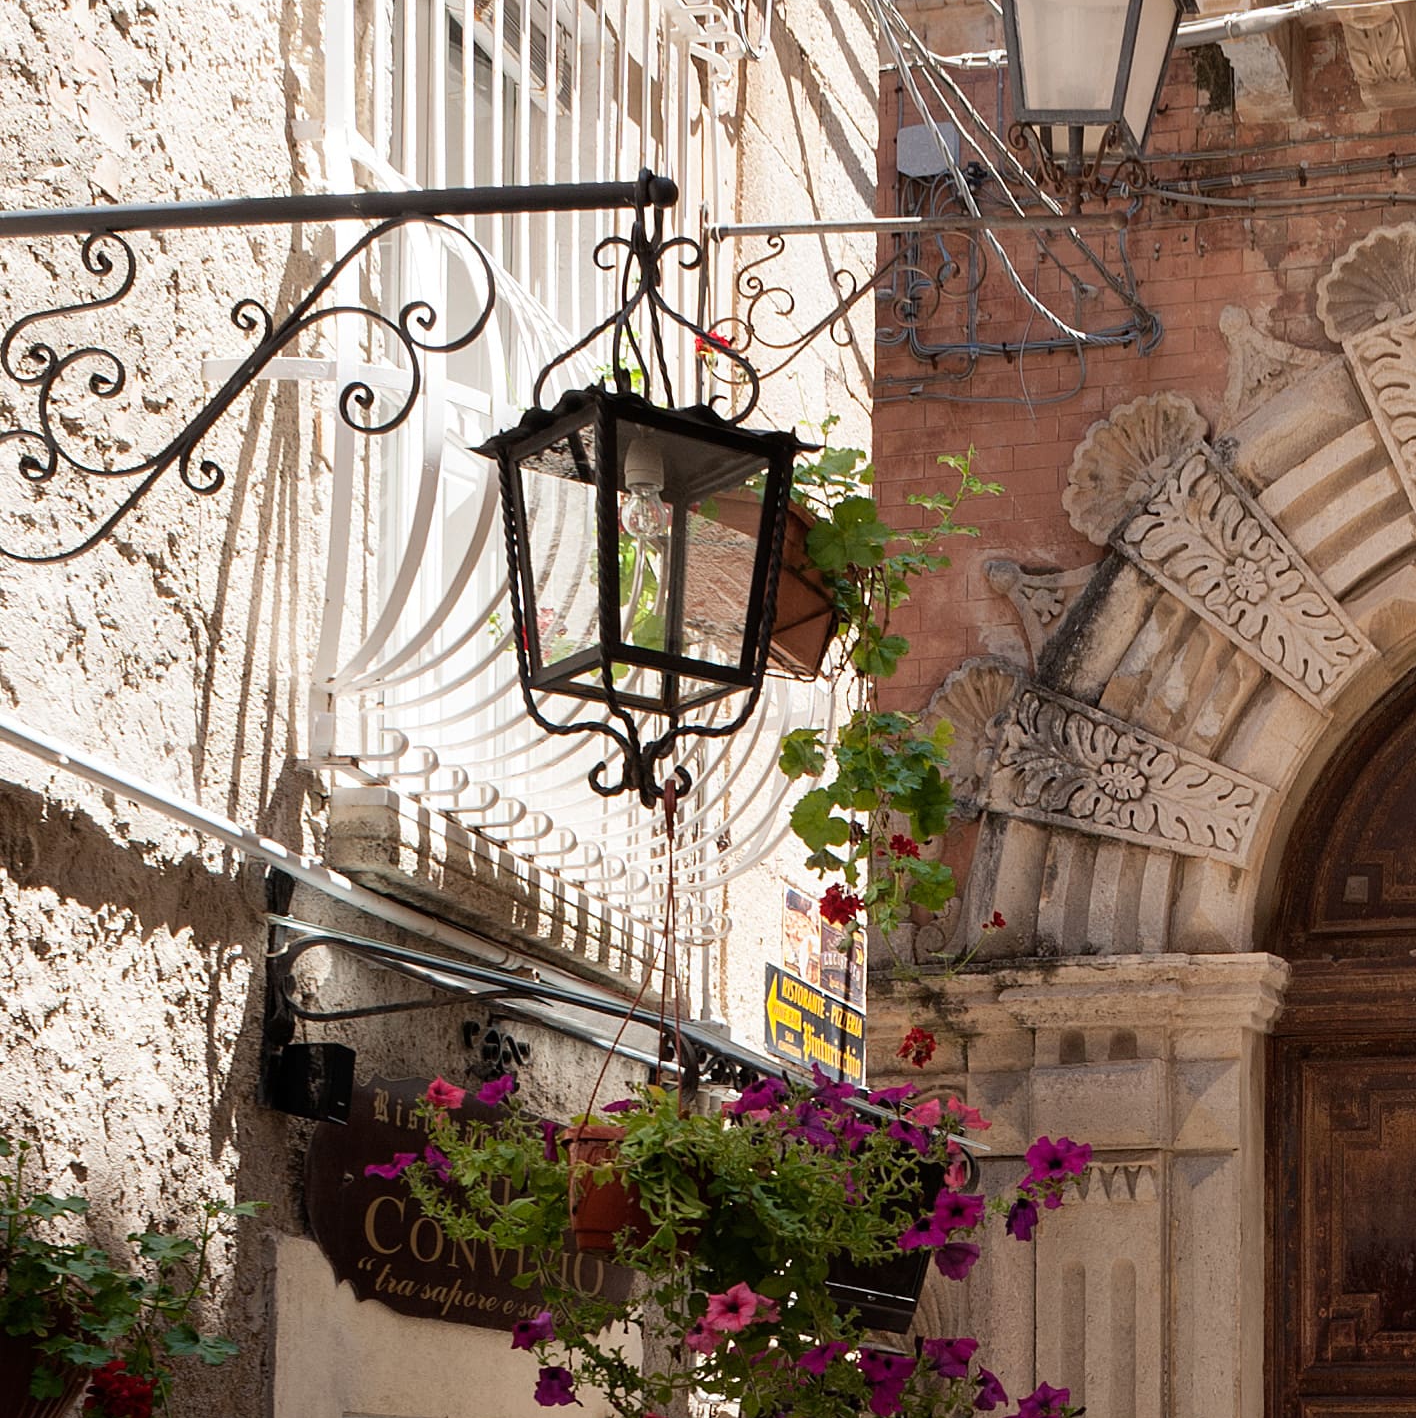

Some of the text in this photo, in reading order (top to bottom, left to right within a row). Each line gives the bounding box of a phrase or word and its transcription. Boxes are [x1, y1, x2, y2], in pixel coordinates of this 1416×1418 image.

[781, 975, 826, 1020] RISTORANTE
[830, 1003, 863, 1039] PIZZERIA
[420, 1278, 500, 1317] sapore
[502, 1300, 516, 1315] e
